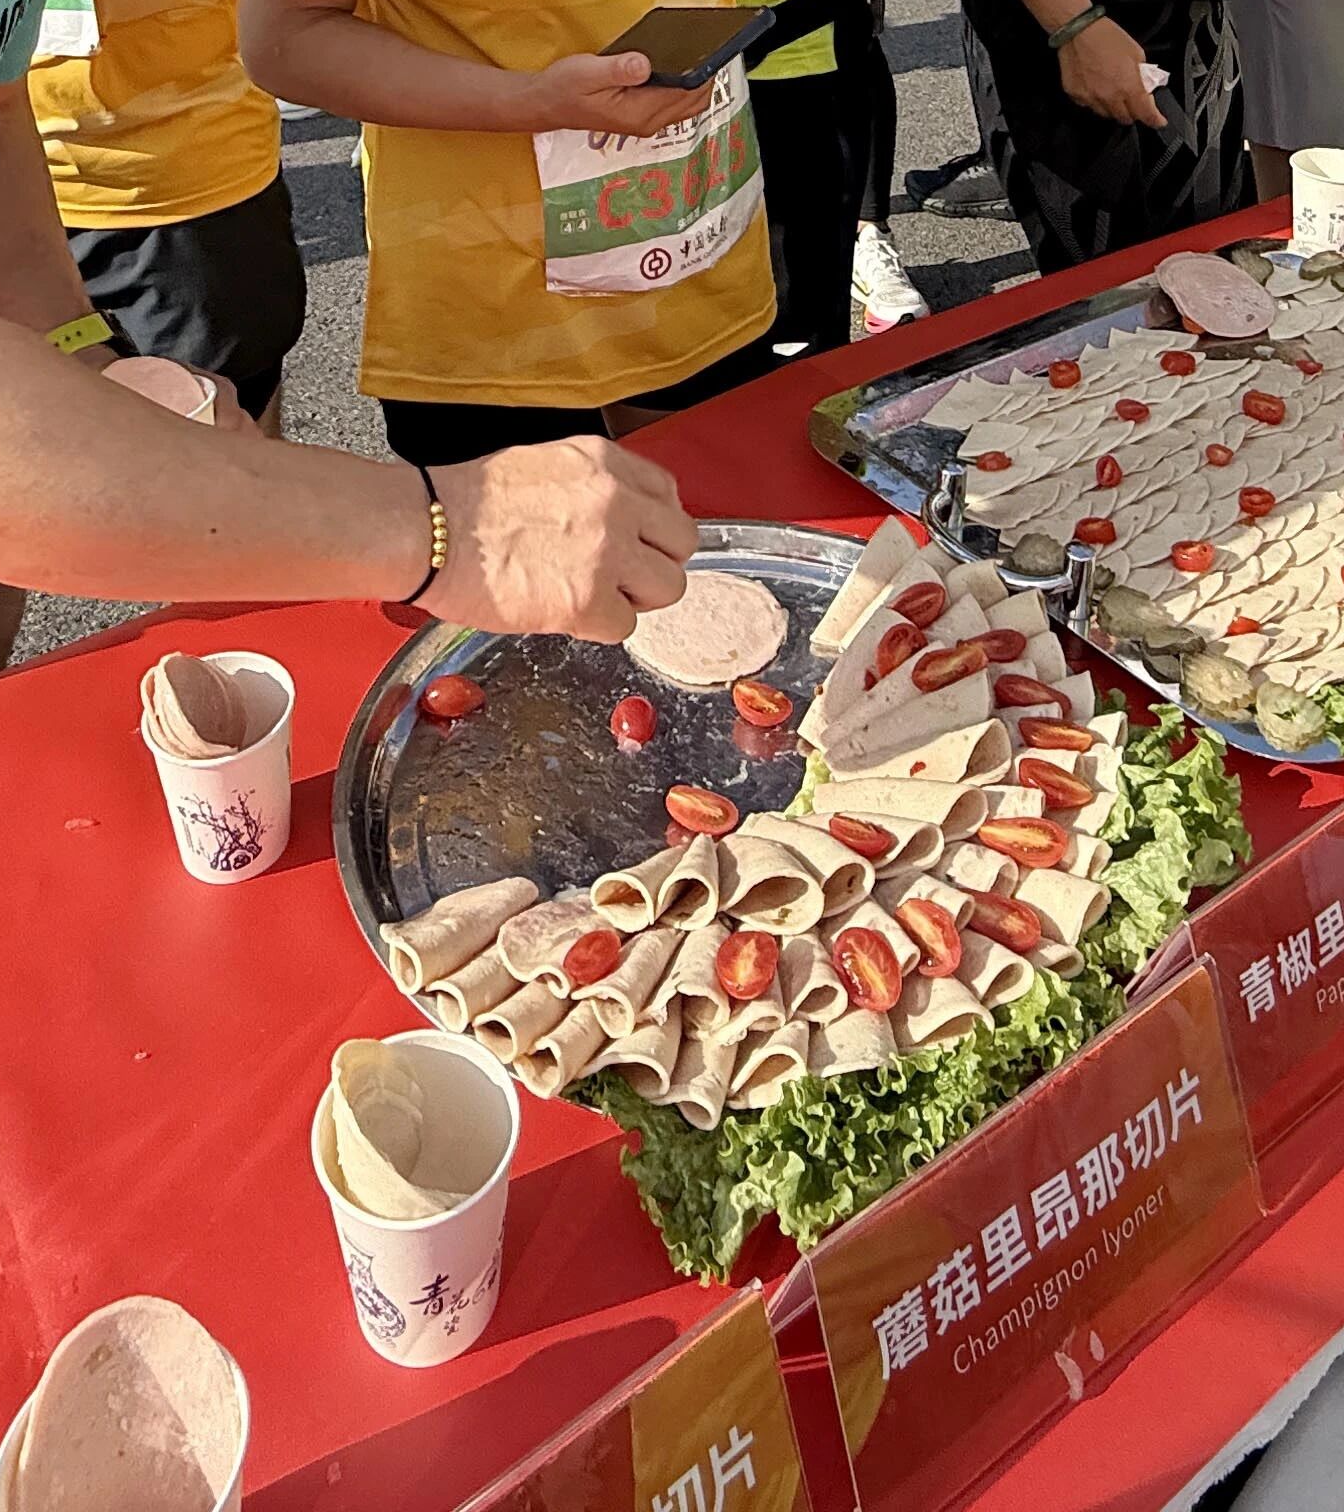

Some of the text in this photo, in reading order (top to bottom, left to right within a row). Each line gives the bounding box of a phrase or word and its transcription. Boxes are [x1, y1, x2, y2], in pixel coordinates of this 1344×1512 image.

[871, 1066, 1205, 1382] 蘑菇里昂那切片
[951, 1244, 1099, 1376] Champignon
